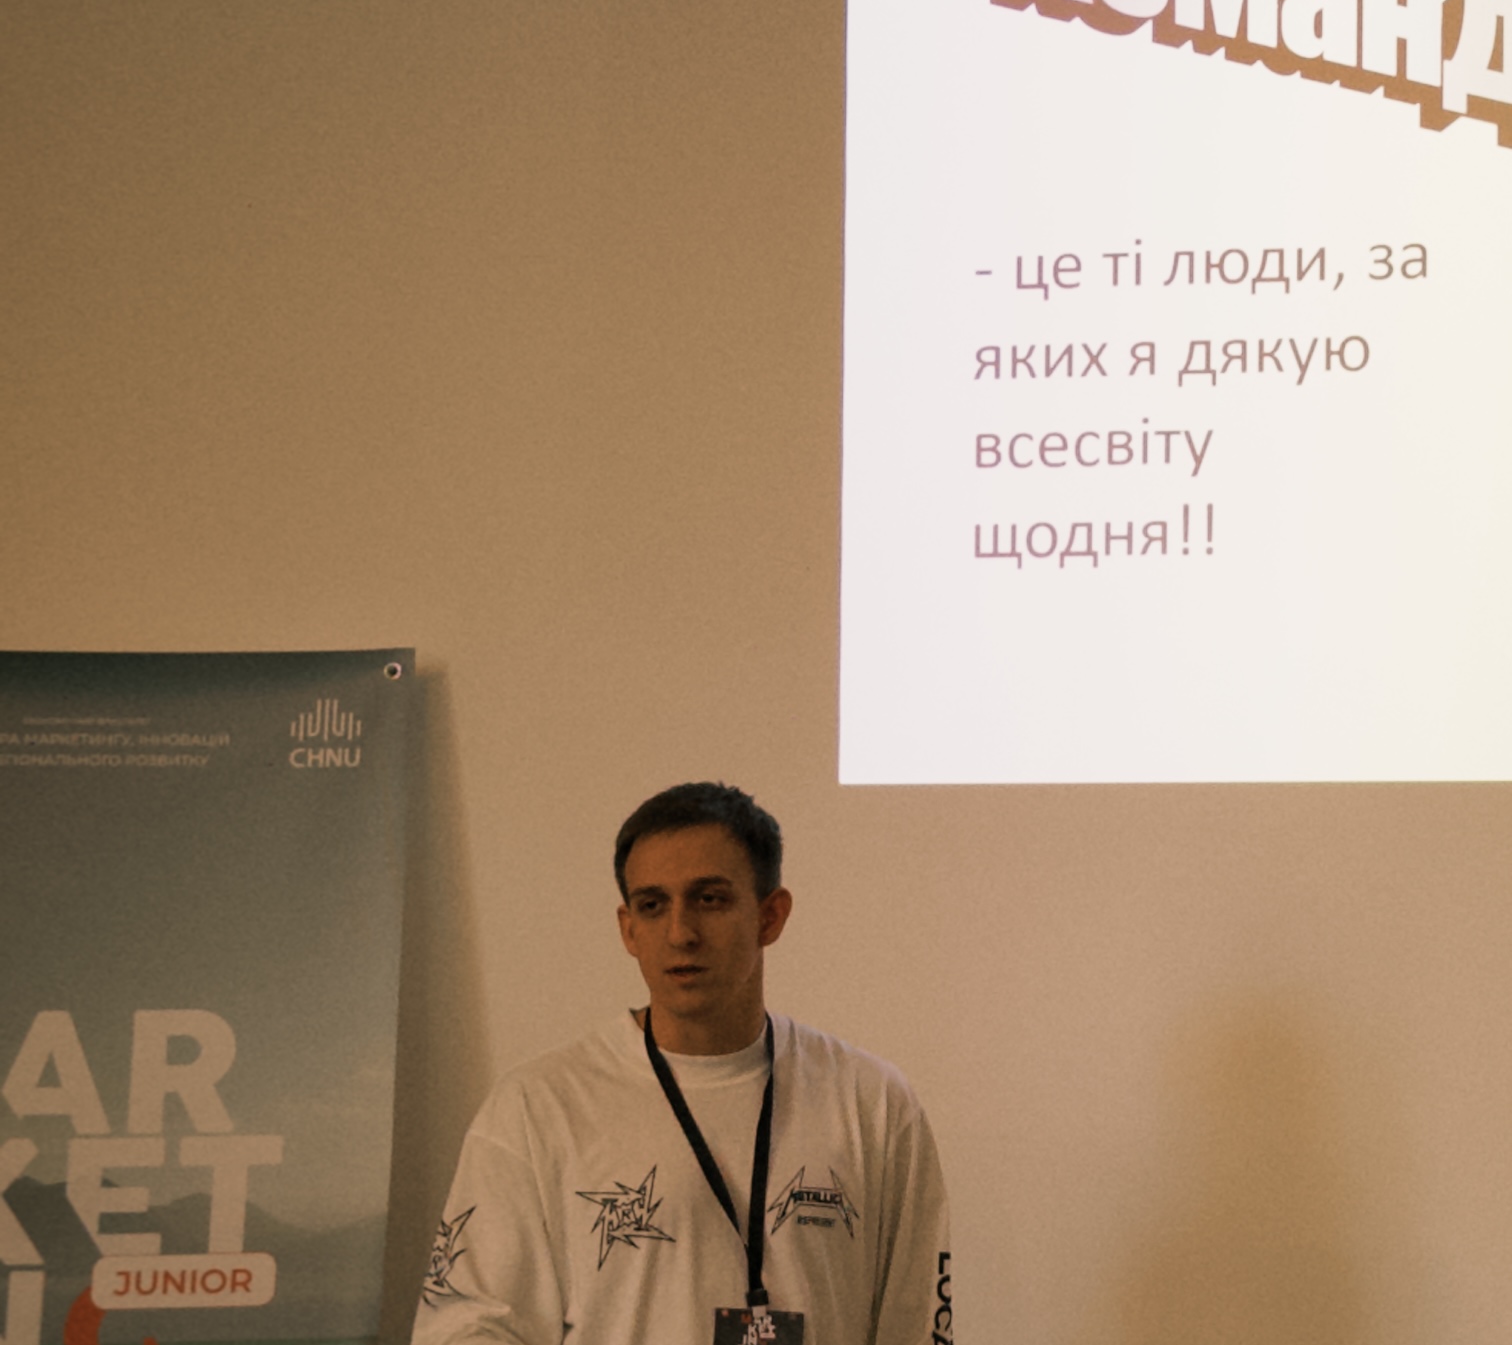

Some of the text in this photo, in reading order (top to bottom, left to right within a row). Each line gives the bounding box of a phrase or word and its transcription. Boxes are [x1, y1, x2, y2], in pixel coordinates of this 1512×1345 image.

[1015, 252, 1082, 301] це
[1102, 238, 1143, 287] ті
[1163, 246, 1345, 295] люди,
[1368, 242, 1429, 281] за
[974, 335, 1371, 387] яких я дякую
[974, 417, 1214, 477] всесвіту
[974, 503, 1214, 569] щодня!!
[288, 746, 362, 769] CHNU
[113, 1267, 253, 1297] JUNIOR
